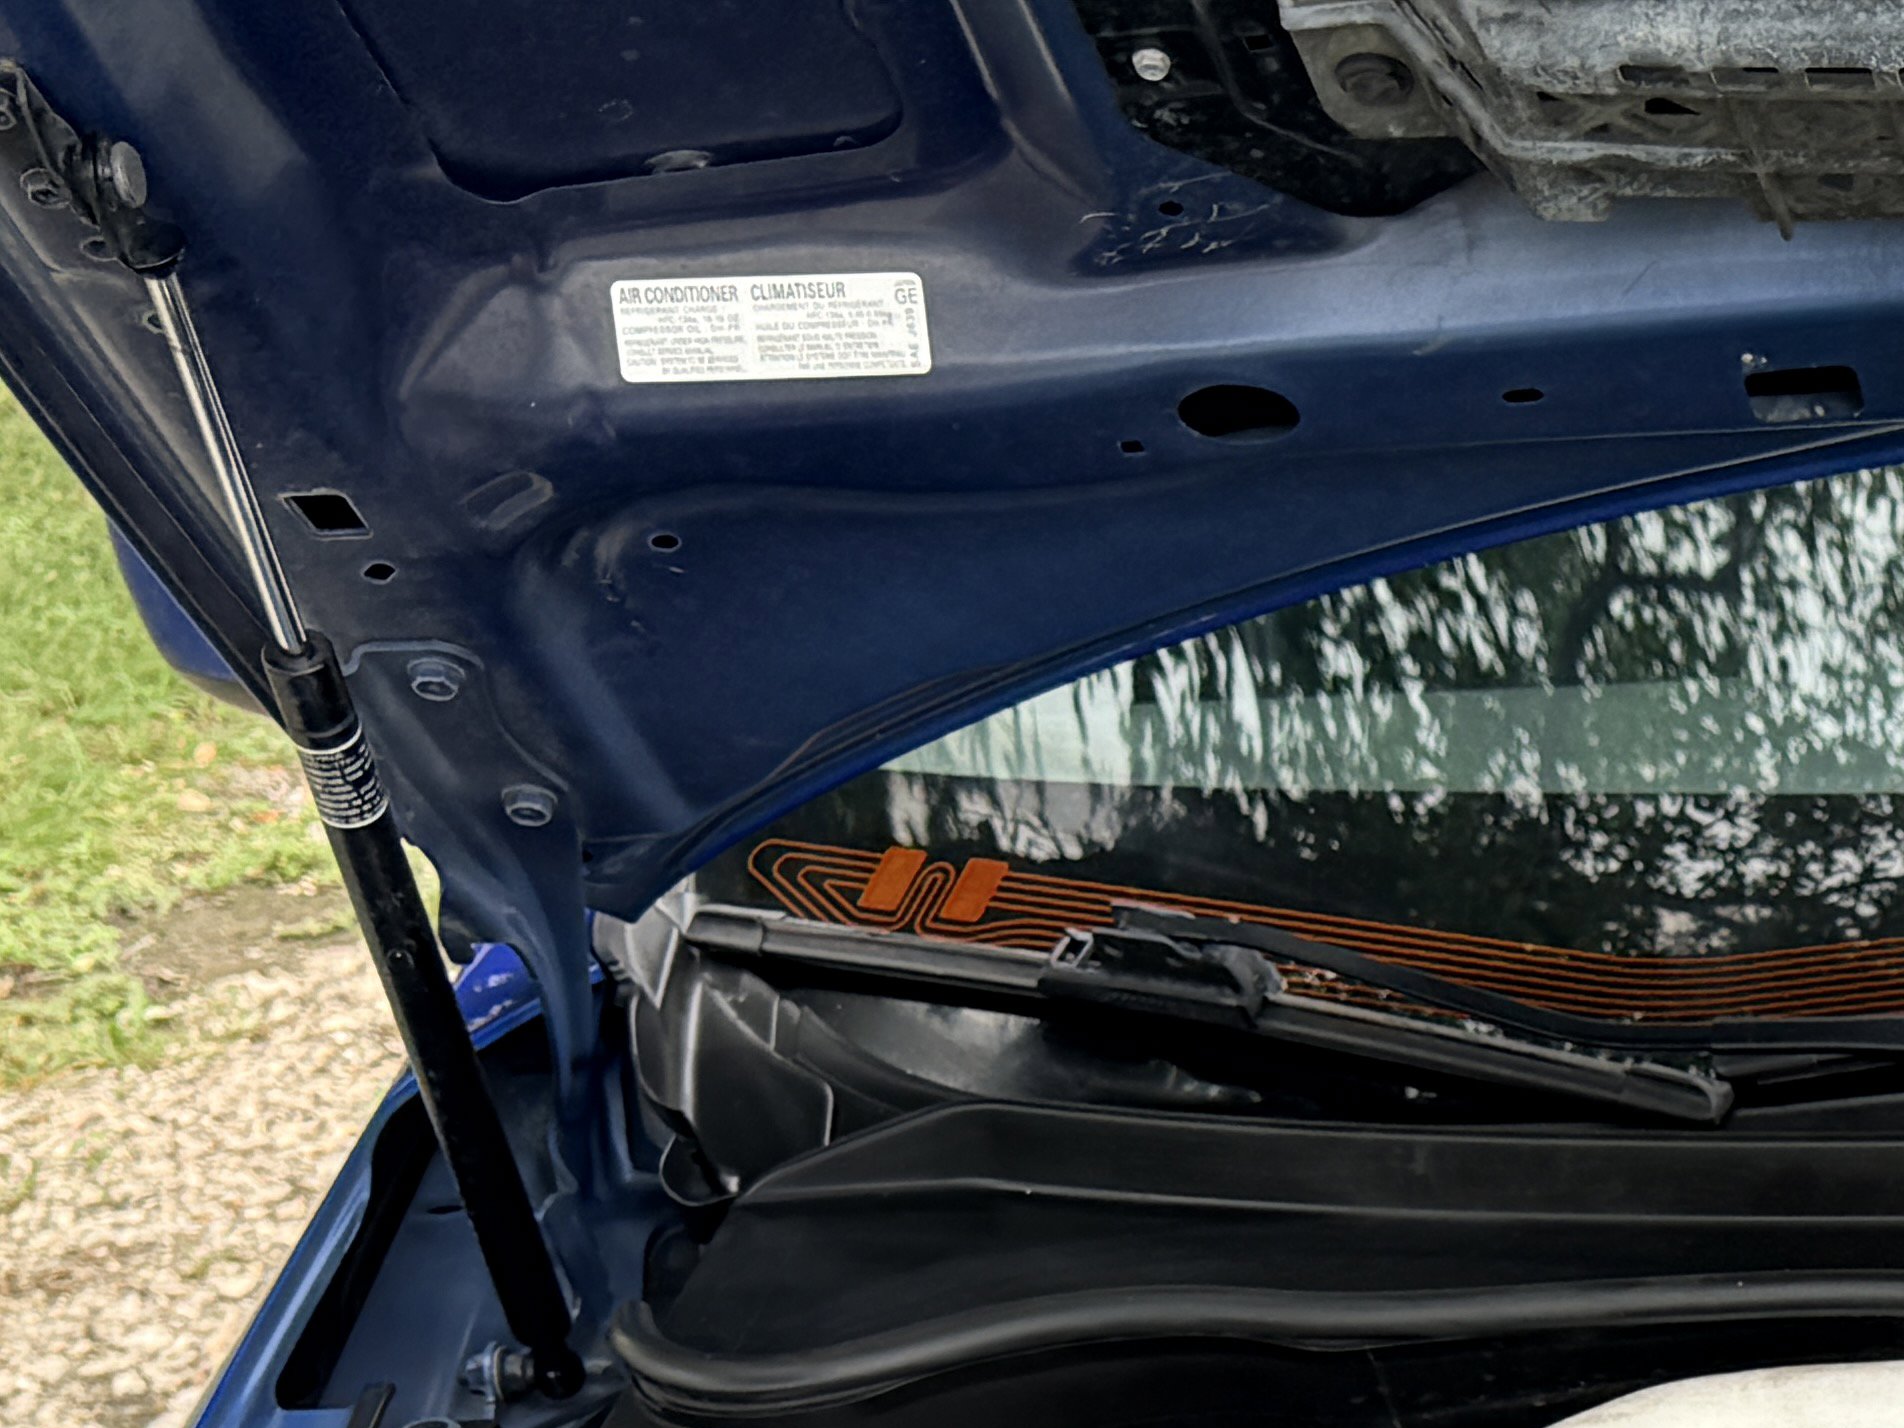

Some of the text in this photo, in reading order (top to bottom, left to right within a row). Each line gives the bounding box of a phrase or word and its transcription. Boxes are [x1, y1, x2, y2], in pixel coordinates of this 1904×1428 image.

[619, 285, 739, 304] AIR CONDITIONER
[750, 281, 846, 301] CLIMATISEUR
[894, 288, 919, 304] GE
